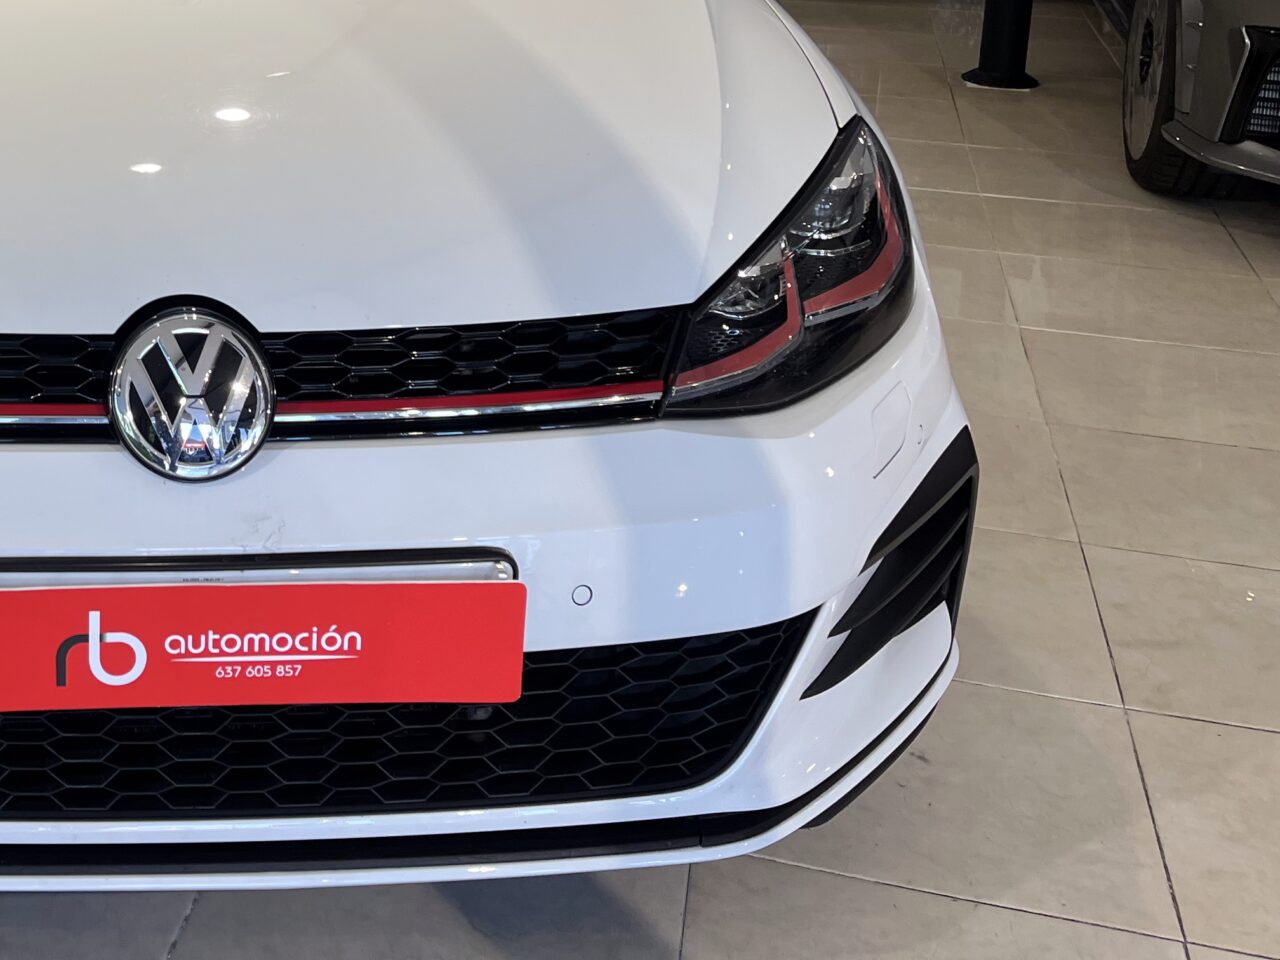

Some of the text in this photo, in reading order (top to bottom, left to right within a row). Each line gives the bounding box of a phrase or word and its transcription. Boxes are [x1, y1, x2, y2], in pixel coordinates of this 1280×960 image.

[55, 610, 148, 687] rb
[164, 624, 362, 655] automoción
[215, 664, 302, 678] 637 605 857
